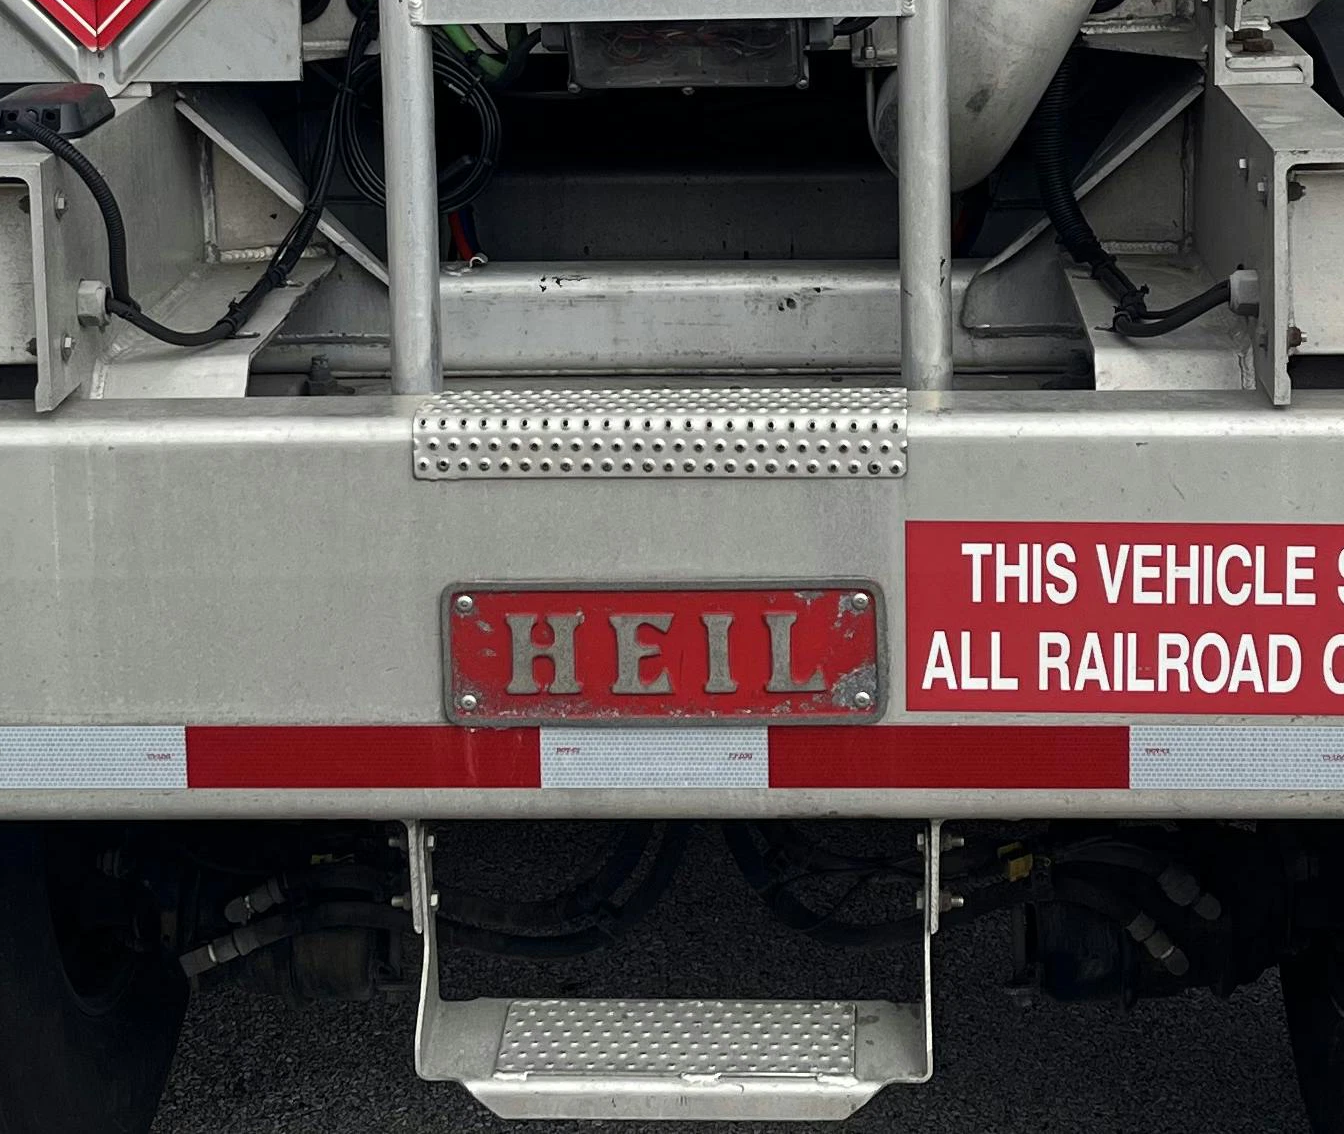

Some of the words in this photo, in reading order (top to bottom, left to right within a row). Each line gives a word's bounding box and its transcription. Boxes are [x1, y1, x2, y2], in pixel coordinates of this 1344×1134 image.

[961, 542, 1078, 605] THIS
[1096, 544, 1316, 606] VEHICLE
[505, 612, 827, 695] HEIL
[921, 630, 1019, 691] ALL
[1038, 631, 1302, 694] RAILROAD
